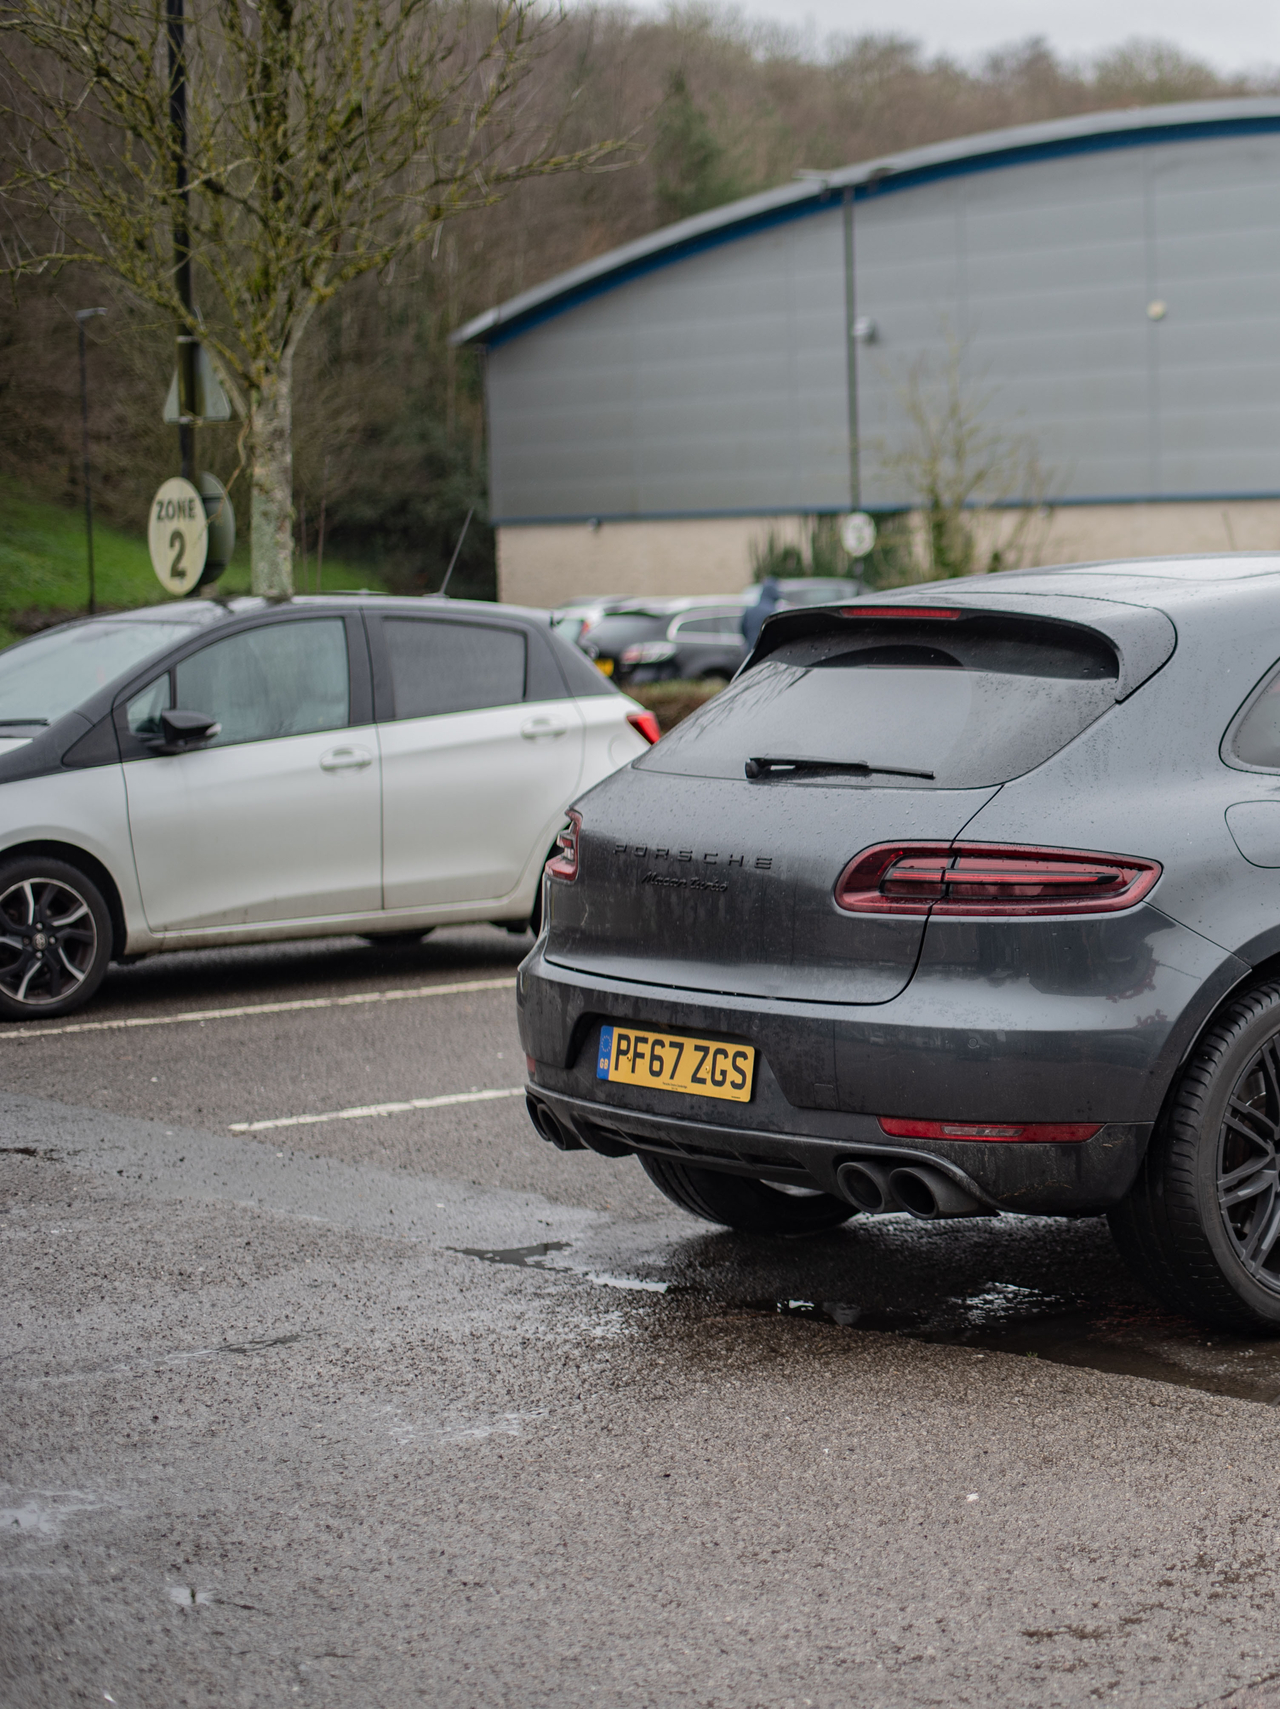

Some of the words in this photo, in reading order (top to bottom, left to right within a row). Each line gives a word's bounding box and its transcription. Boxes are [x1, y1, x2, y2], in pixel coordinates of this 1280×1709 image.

[156, 498, 196, 520] ZONE
[169, 528, 187, 578] 2
[614, 844, 773, 870] PORSCHE
[641, 870, 687, 888] Macan
[599, 1058, 609, 1070] GB
[614, 1033, 684, 1080] PF67
[691, 1044, 749, 1090] ZGS
